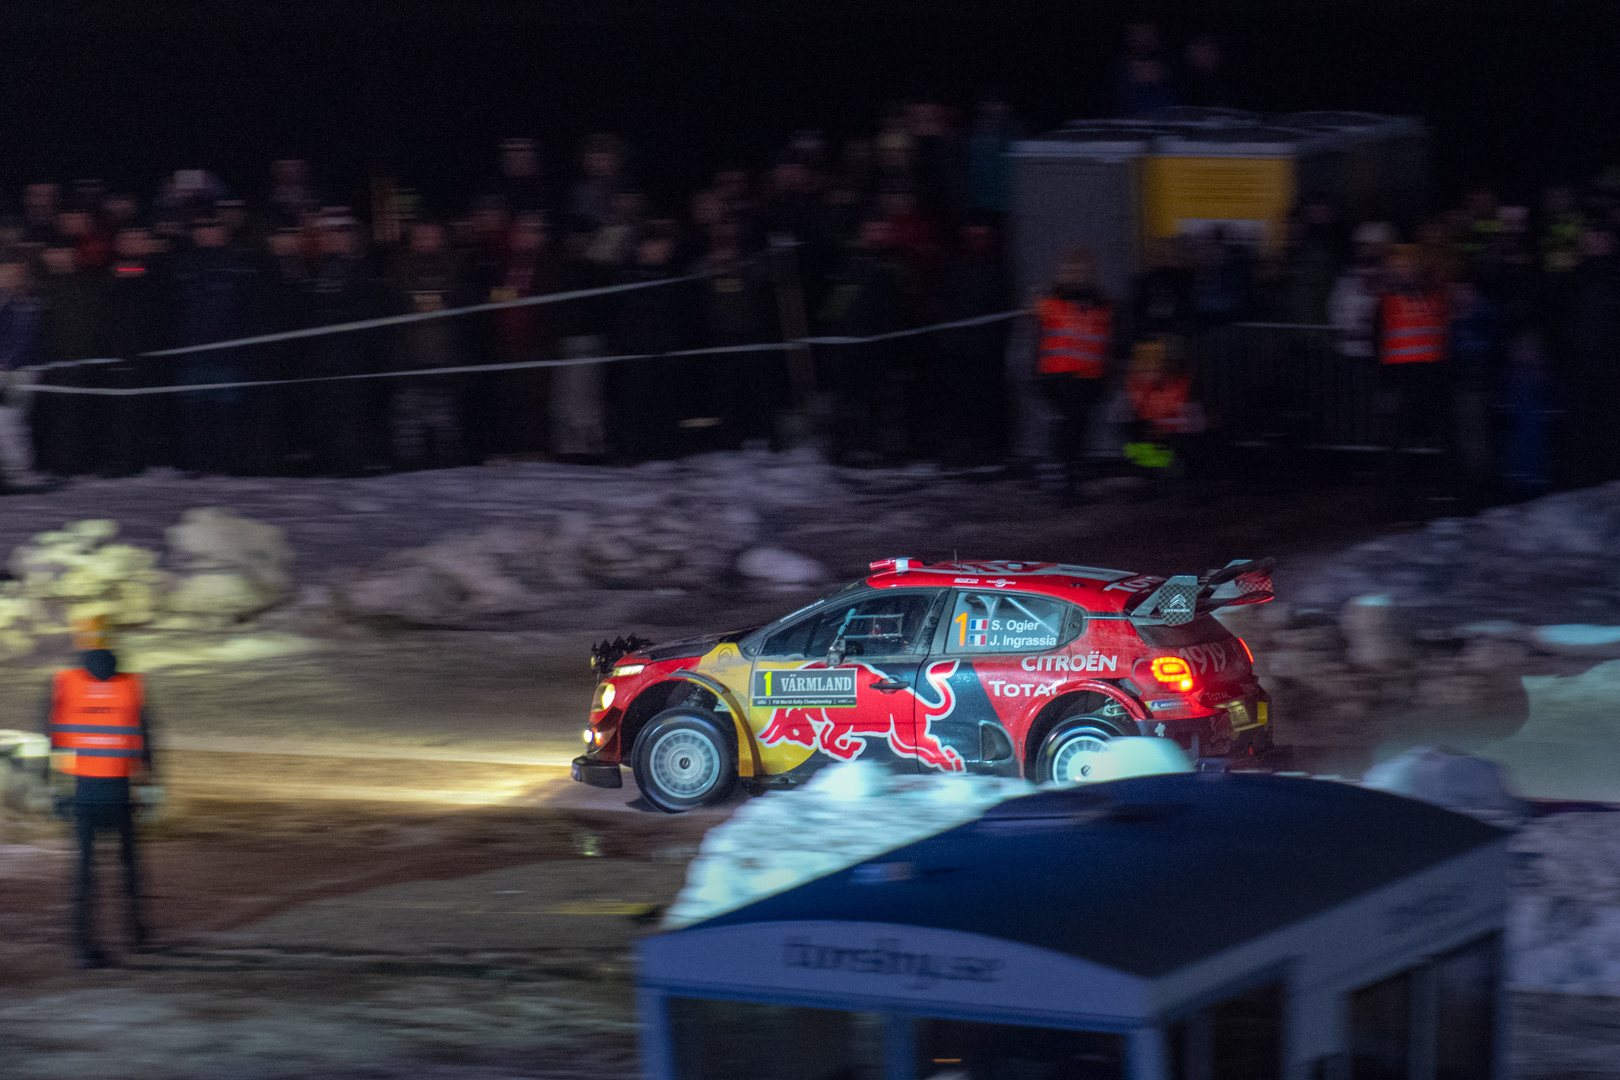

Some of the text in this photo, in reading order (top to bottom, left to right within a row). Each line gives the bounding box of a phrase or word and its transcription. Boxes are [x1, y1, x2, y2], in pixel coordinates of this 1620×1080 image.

[955, 612, 968, 646] 1
[991, 620, 1040, 633] S. Ogier
[989, 635, 1057, 648] J. Ingrassia
[1021, 650, 1118, 672] CITROËN
[1179, 642, 1227, 678] 1919
[764, 671, 772, 696] 1
[781, 674, 852, 692] VÄRMLAND
